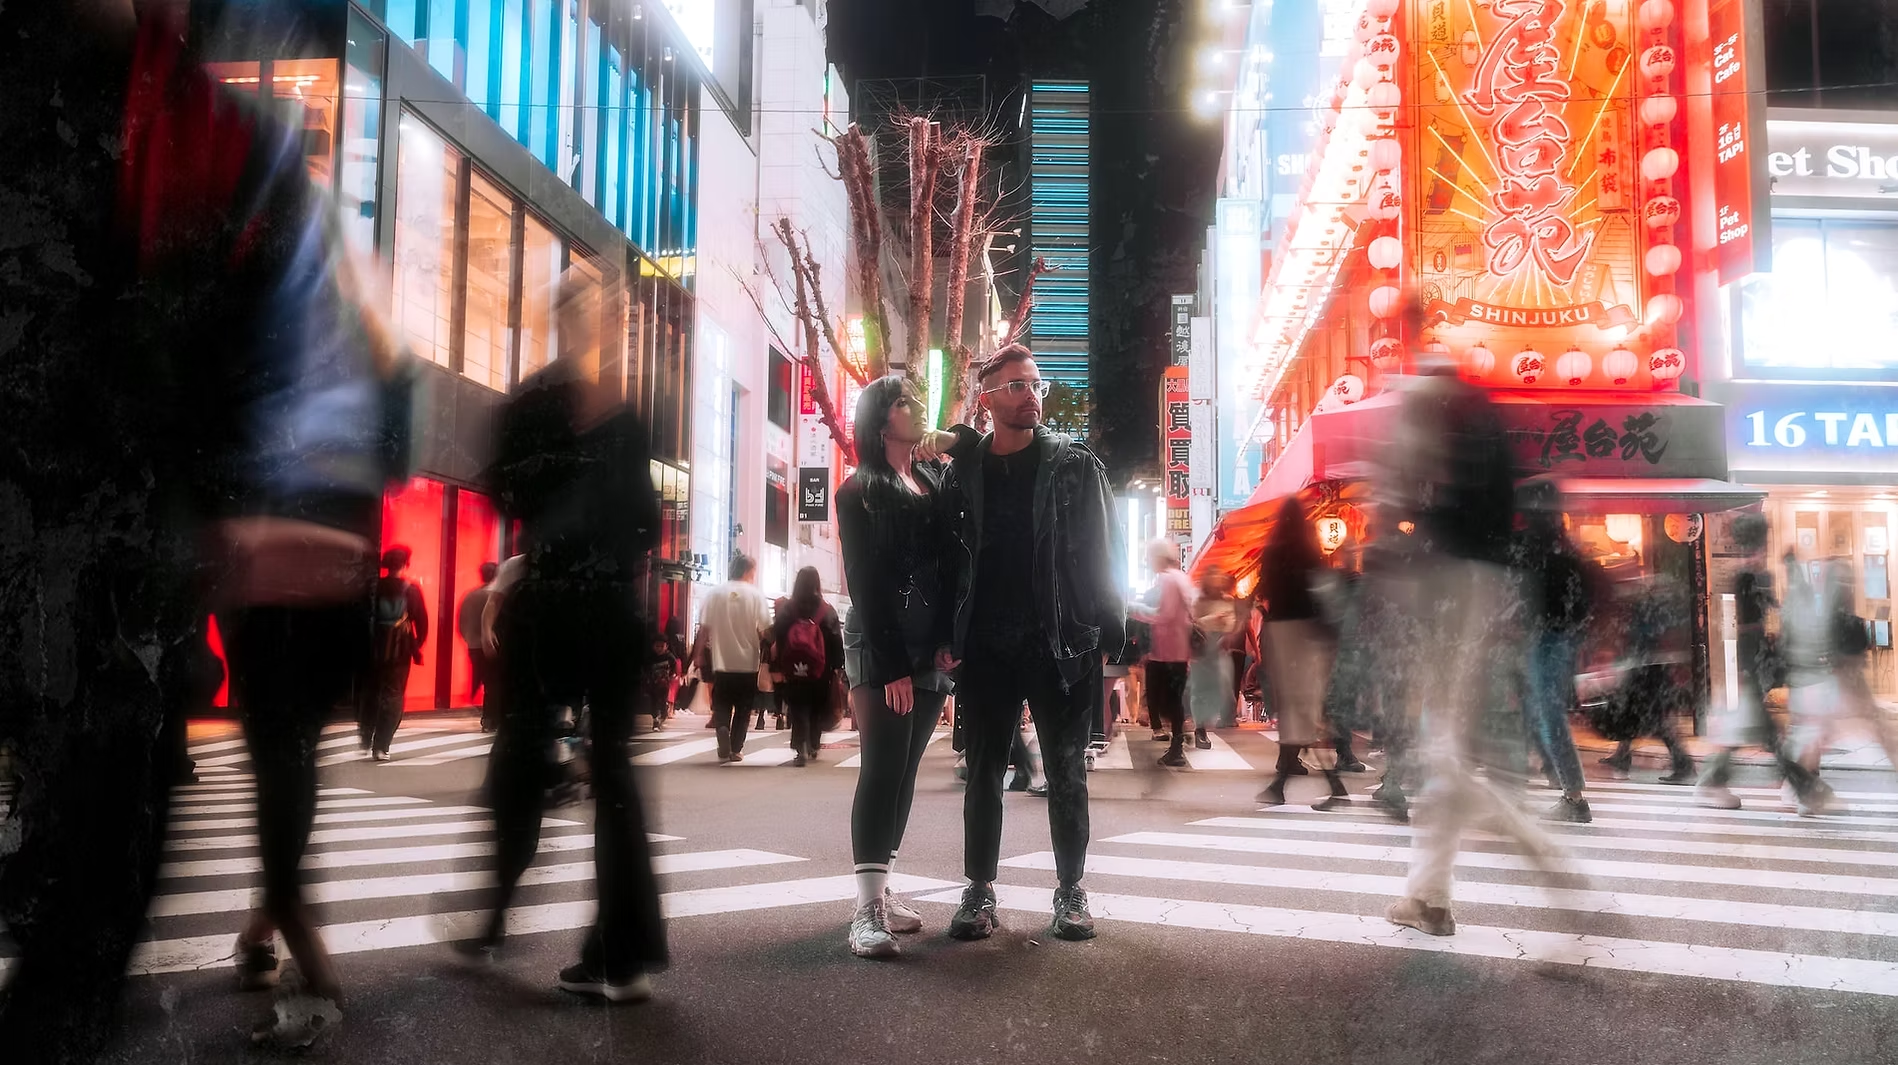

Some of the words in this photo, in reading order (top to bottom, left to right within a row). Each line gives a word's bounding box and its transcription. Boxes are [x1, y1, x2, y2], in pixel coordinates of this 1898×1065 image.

[1714, 47, 1735, 68] Cat
[1714, 62, 1740, 84] Cafe
[1461, 0, 1594, 286] 屋台苑
[1718, 131, 1734, 150] 16
[1718, 140, 1744, 164] TAPI
[1768, 146, 1814, 176] et
[1277, 153, 1305, 176] SH
[1720, 211, 1739, 230] Pet
[1720, 224, 1748, 245] Shop
[1469, 304, 1590, 325] SHINJUKU
[1538, 409, 1671, 469] 屋台苑
[1746, 410, 1806, 448] 16
[1168, 509, 1189, 519] DUT
[1168, 519, 1190, 530] FRE
